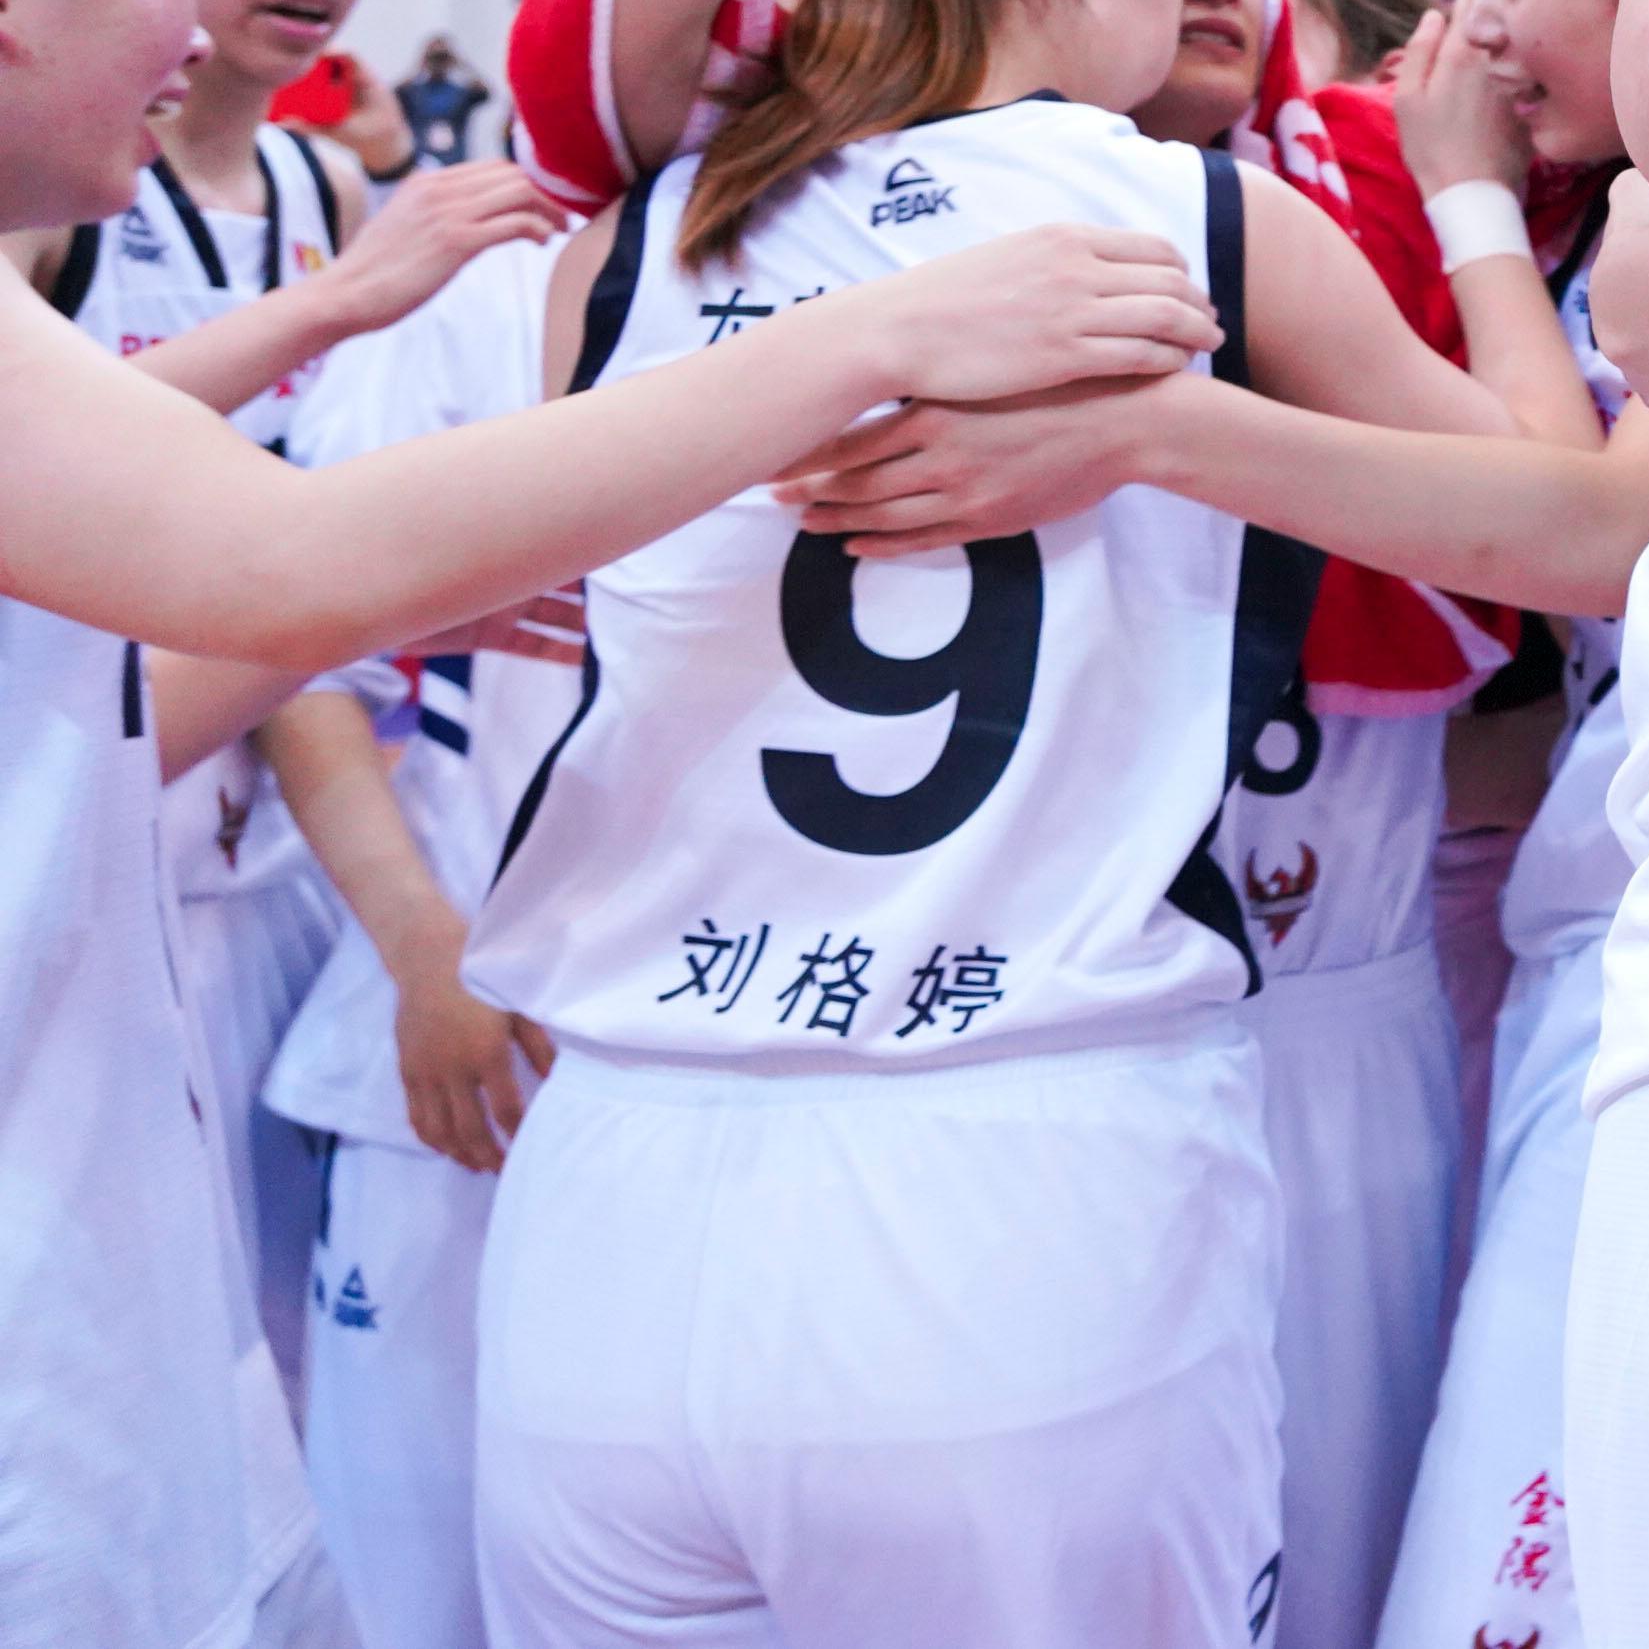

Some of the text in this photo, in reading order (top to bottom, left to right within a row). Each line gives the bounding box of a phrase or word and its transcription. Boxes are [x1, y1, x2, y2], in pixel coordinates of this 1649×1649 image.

[869, 186, 957, 228] PEAK
[760, 528, 1044, 856] 9
[656, 917, 1009, 1039] 刘格婷
